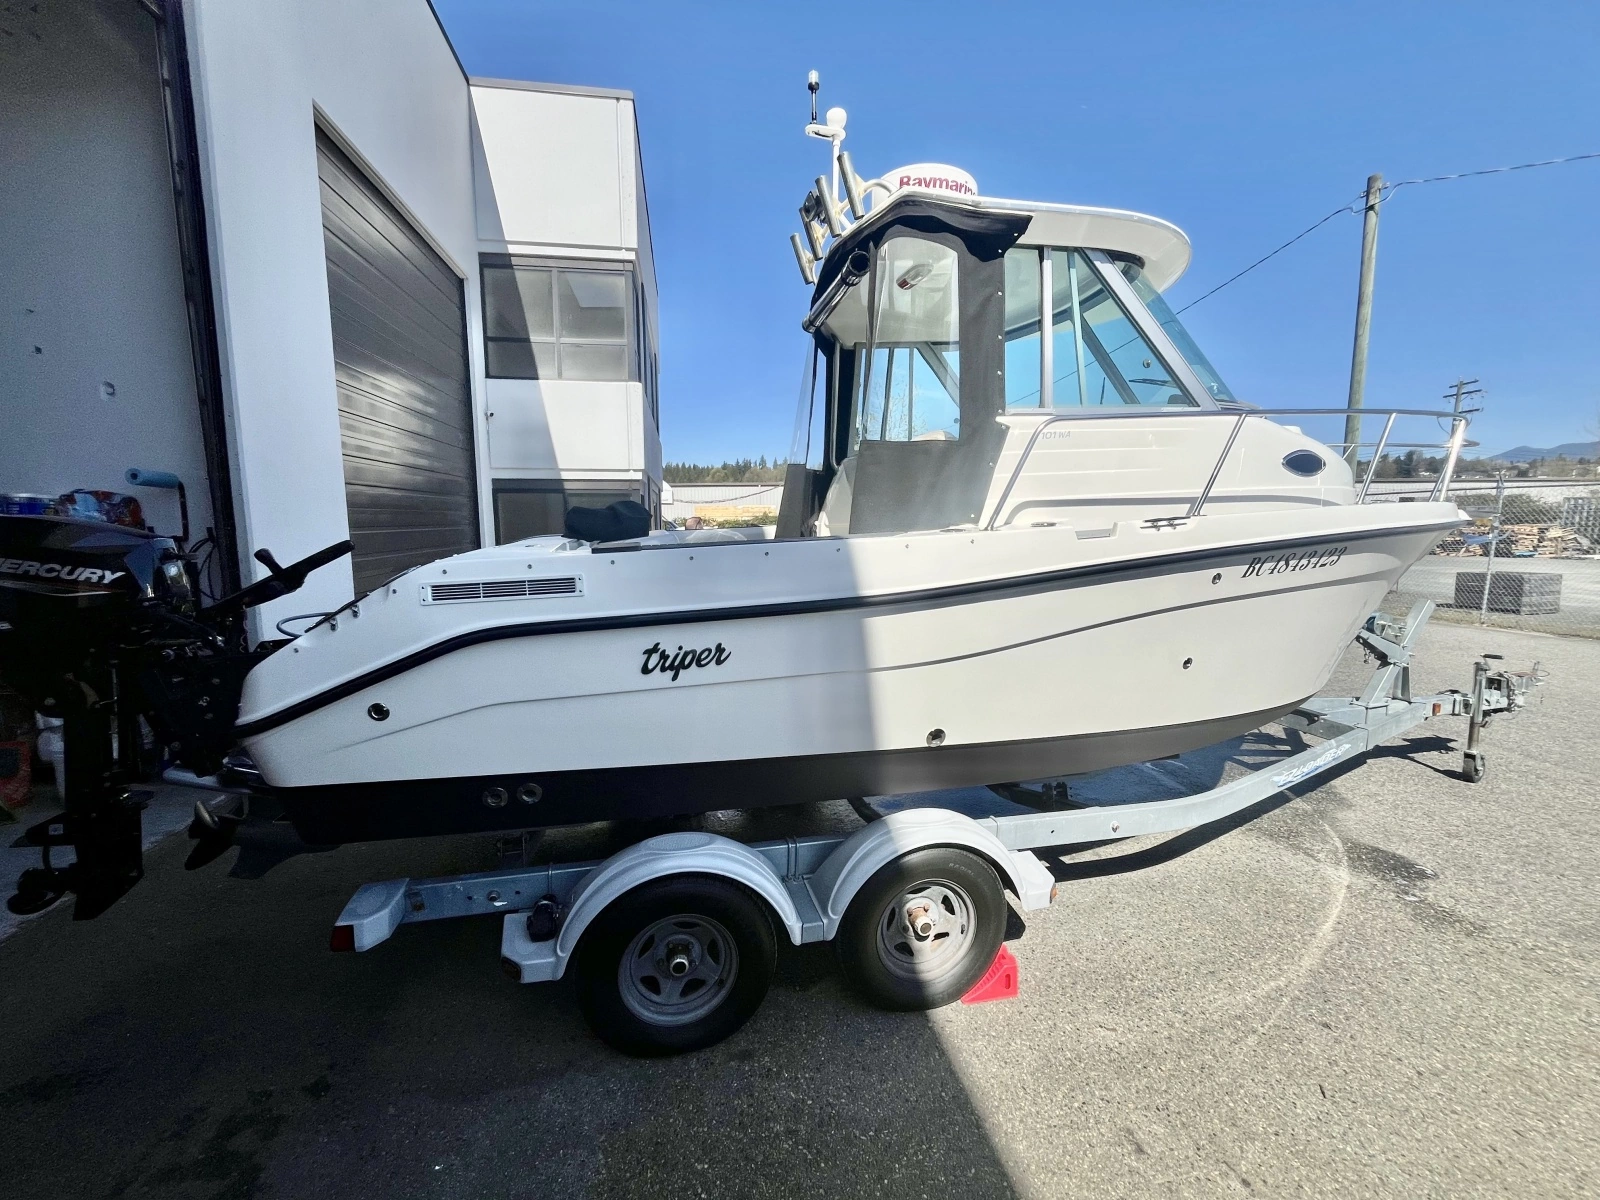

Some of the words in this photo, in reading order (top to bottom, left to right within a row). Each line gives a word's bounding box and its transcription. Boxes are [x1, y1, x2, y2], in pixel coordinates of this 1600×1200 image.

[899, 175, 976, 196] Raymarin
[1041, 432, 1056, 440] 101
[1058, 431, 1071, 439] WA
[0, 557, 126, 584] ERCURY
[641, 642, 732, 682] triper
